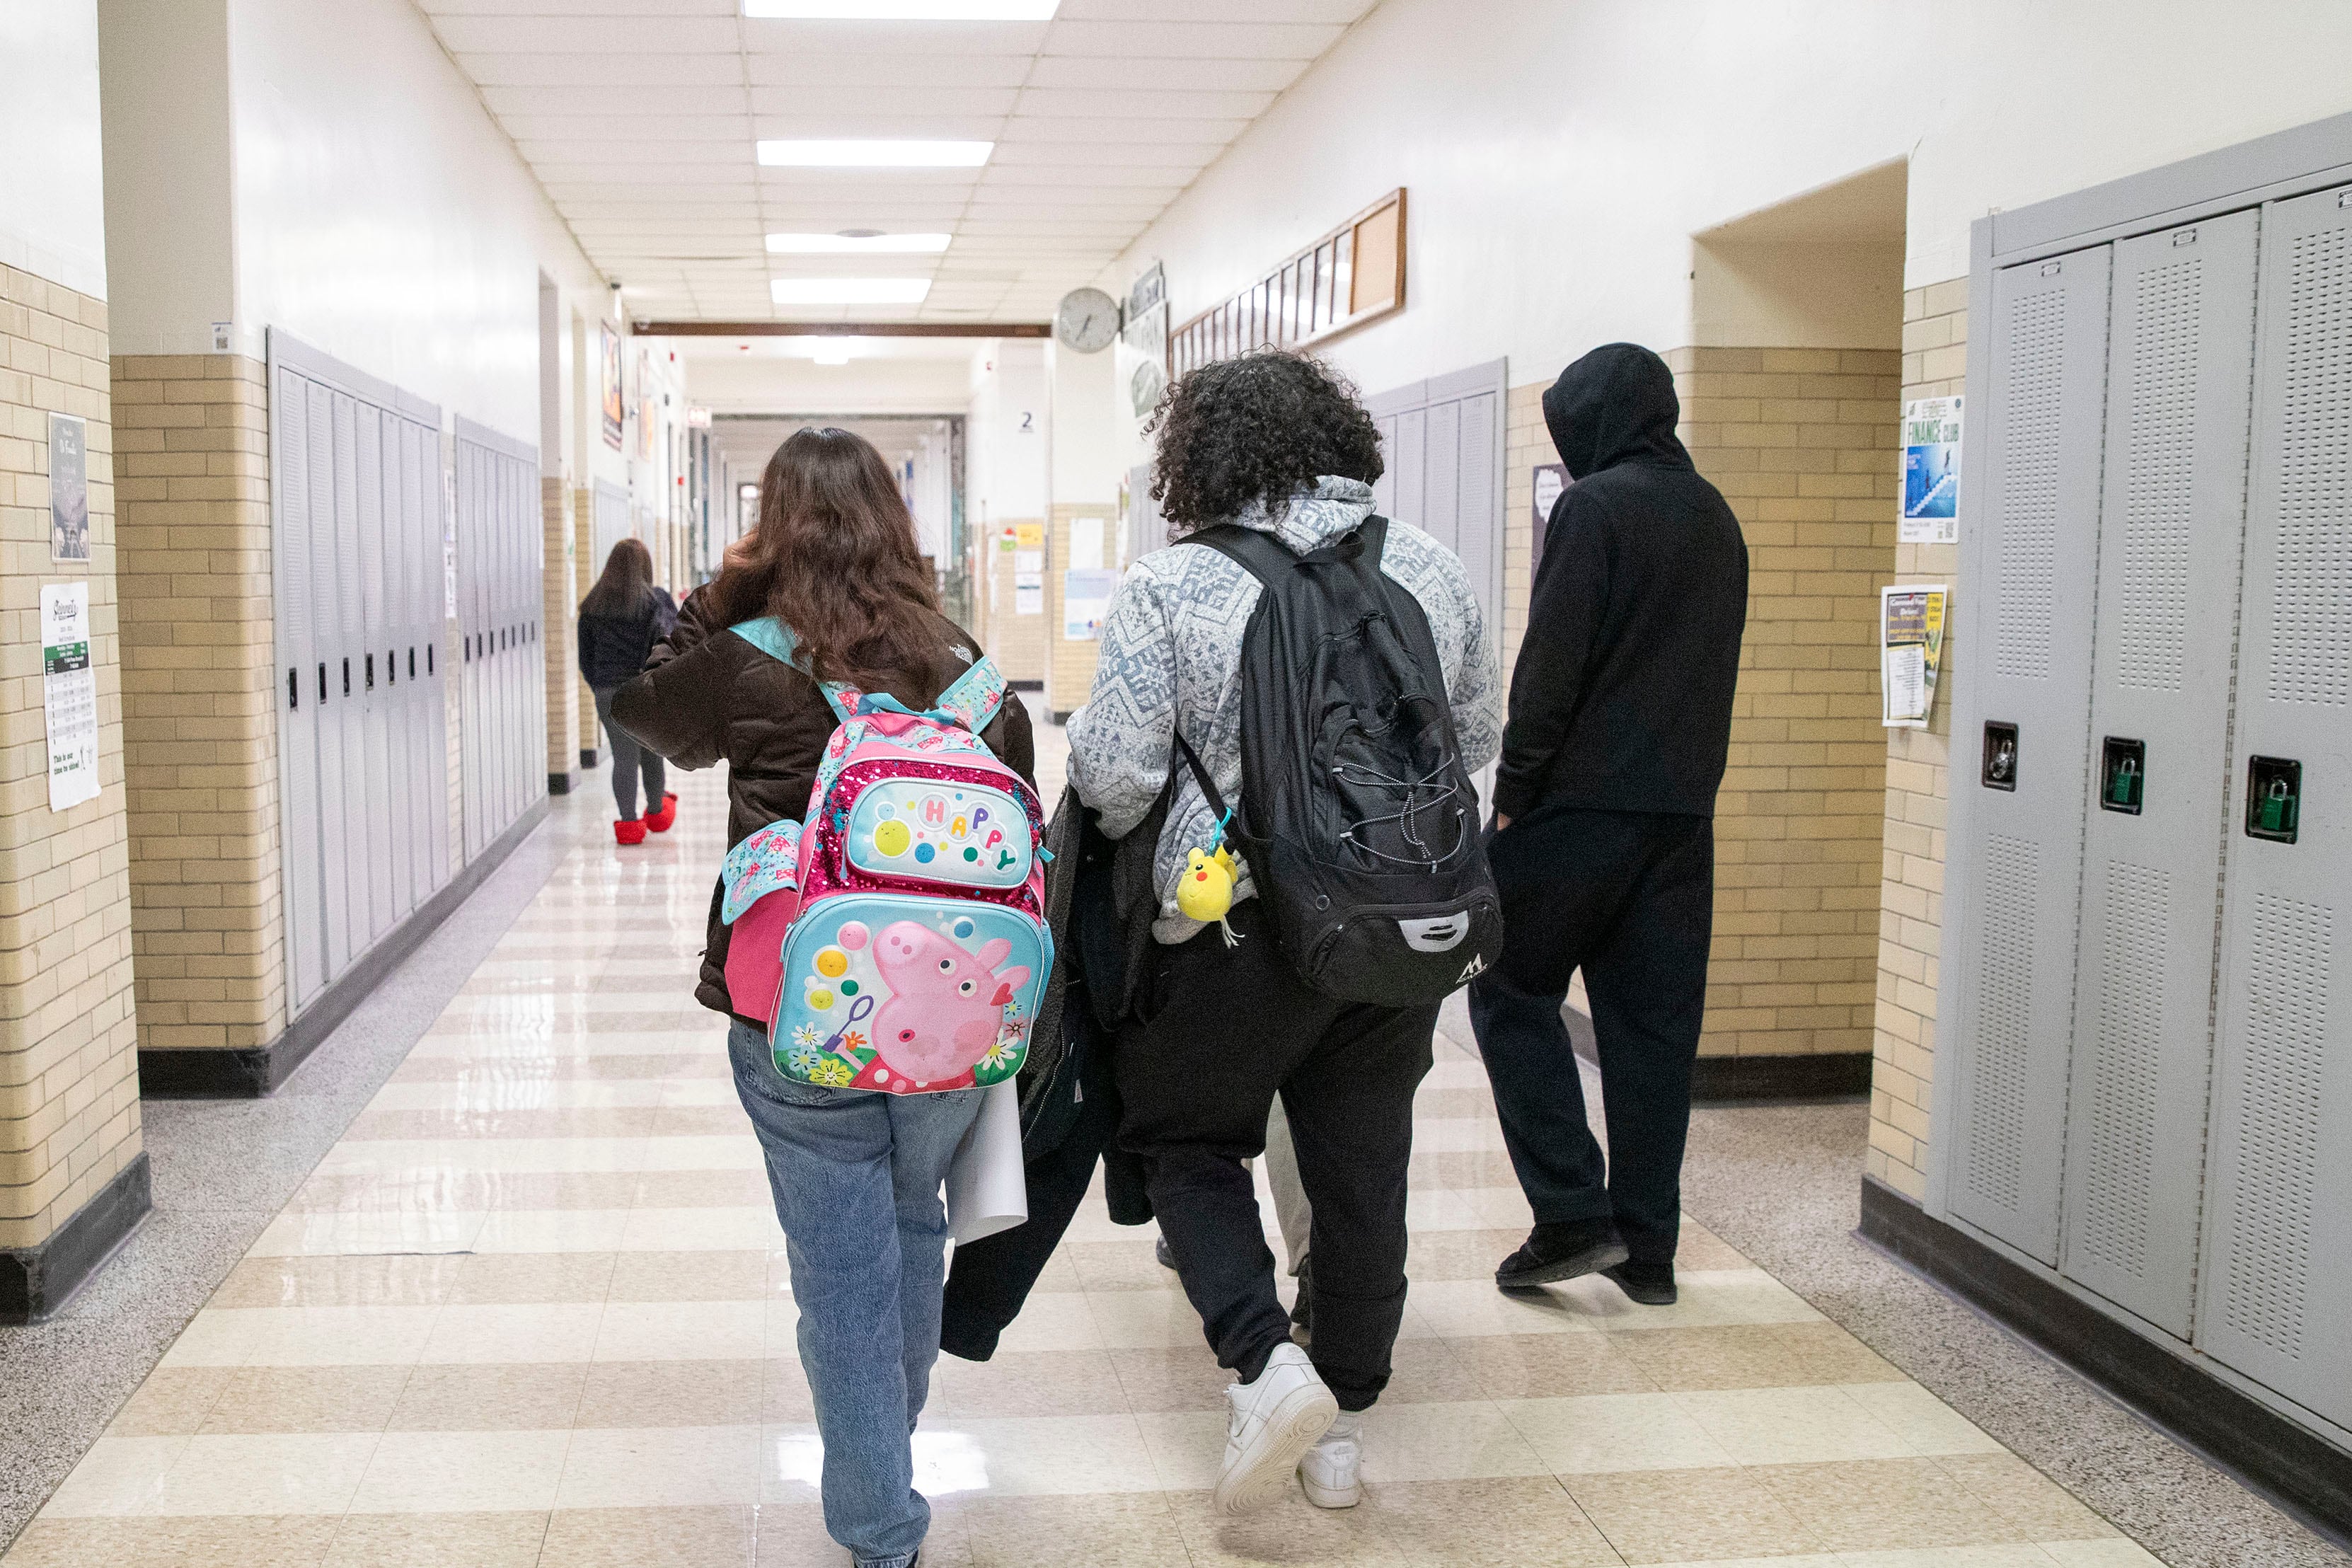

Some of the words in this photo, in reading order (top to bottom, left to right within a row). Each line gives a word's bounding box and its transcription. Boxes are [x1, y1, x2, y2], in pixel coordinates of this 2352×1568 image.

[1022, 411, 1034, 428] 2
[1908, 419, 1942, 444] FINANCE
[1944, 423, 1959, 442] CLUB
[926, 800, 1016, 870] HAPPY
